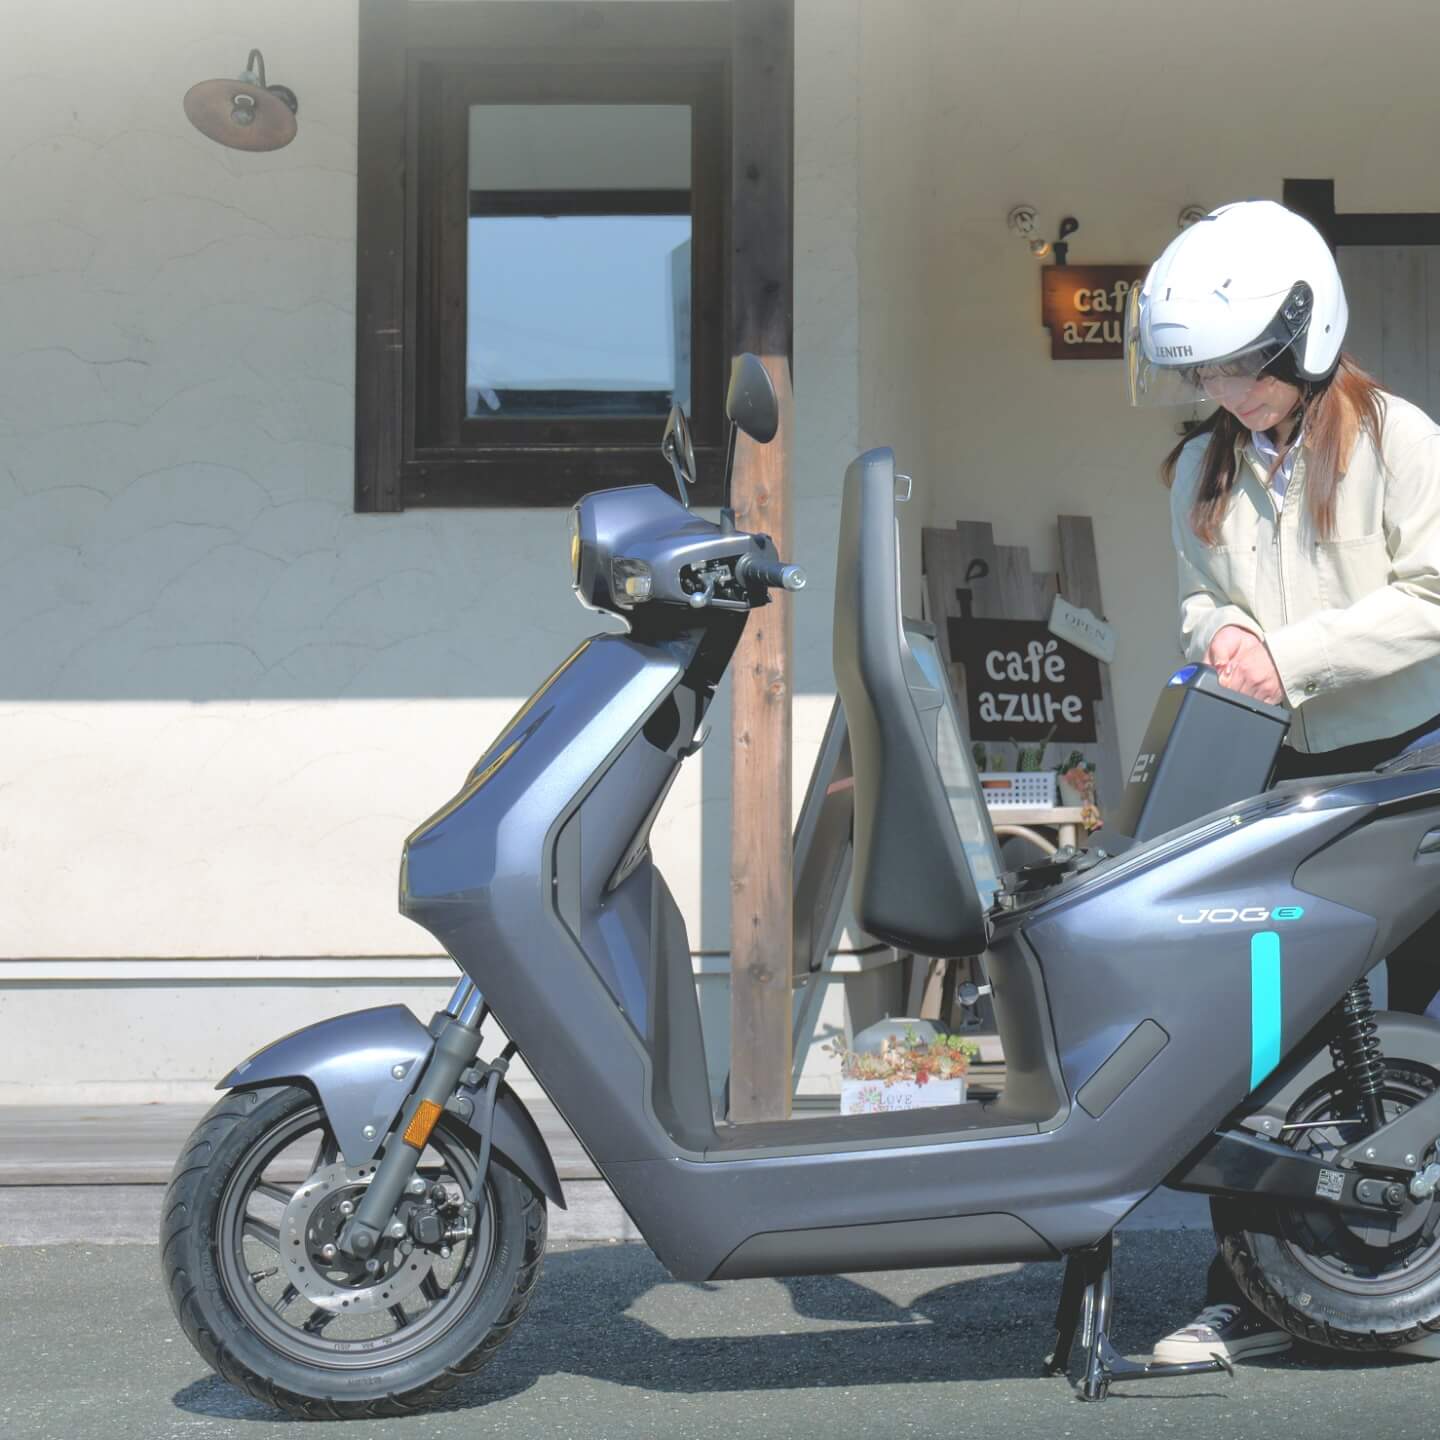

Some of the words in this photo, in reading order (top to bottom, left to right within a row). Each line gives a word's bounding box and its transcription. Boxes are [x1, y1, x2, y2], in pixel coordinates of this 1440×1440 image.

[1073, 279, 1142, 313] caf
[1063, 320, 1122, 345] azu
[1064, 611, 1106, 641] OPEN
[985, 640, 1066, 683] café
[978, 691, 1083, 723] azure
